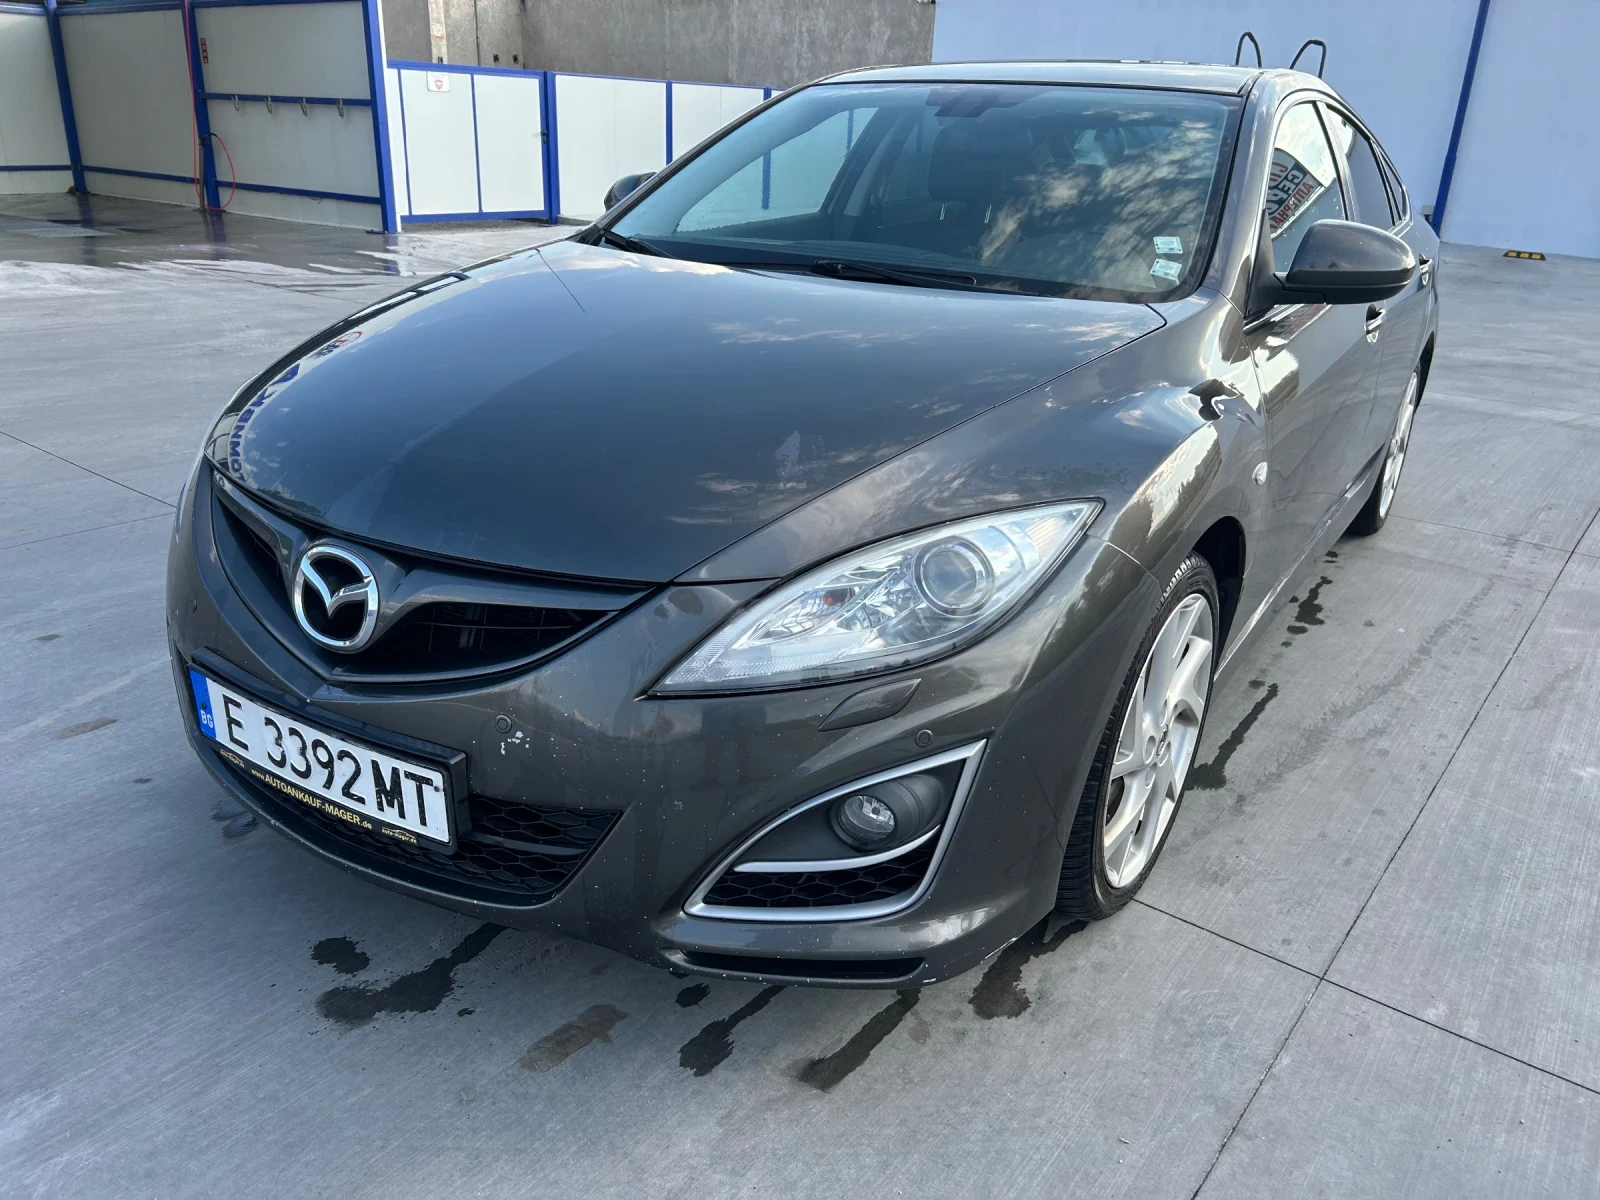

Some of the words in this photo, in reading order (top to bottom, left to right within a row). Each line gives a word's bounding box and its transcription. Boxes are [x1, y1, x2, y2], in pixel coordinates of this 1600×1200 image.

[200, 709, 214, 729] BG
[223, 693, 249, 752] E
[264, 716, 367, 806] 3392
[370, 758, 434, 828] MT
[251, 769, 373, 830] www.AUTOANKAUF-MAGER.de
